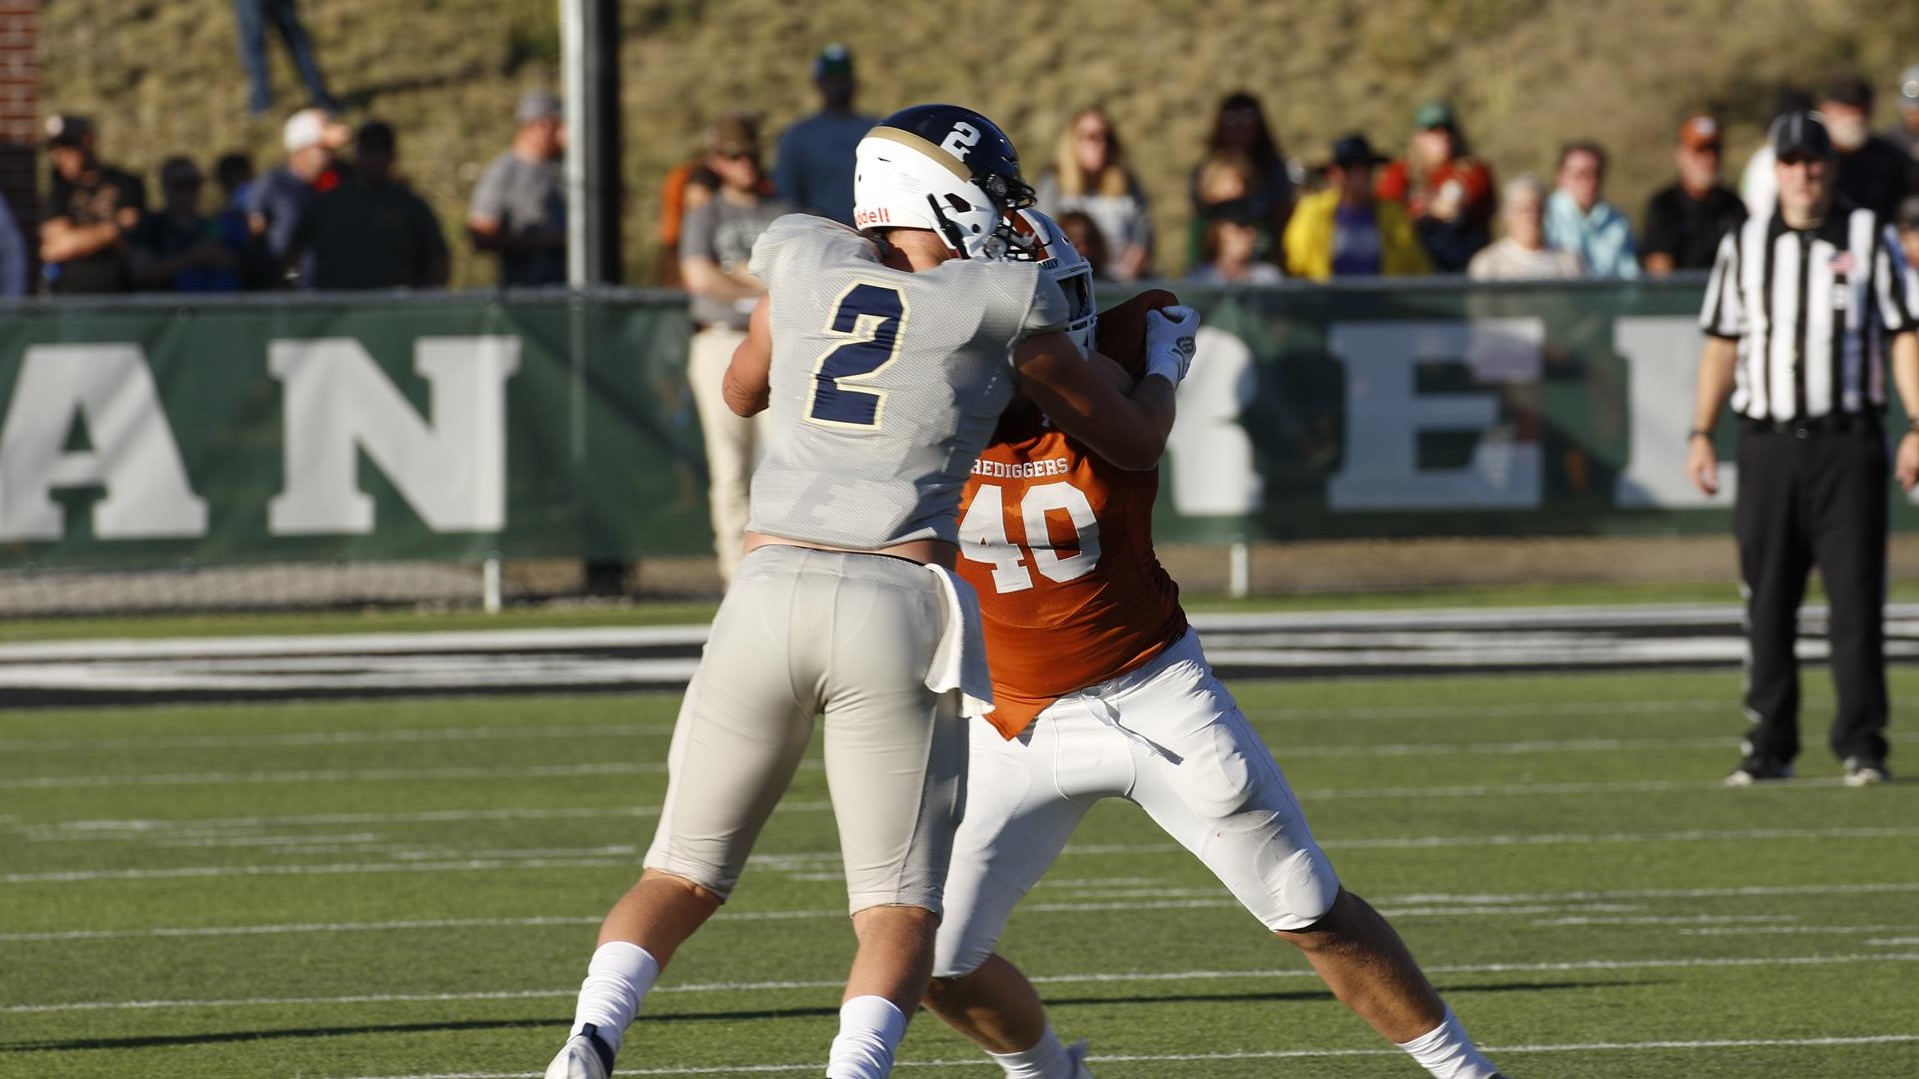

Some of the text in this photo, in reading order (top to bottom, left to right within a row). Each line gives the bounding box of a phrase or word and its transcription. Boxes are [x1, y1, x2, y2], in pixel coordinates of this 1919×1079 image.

[940, 121, 981, 162] 2
[803, 278, 911, 431] 2
[957, 481, 1102, 594] 40
